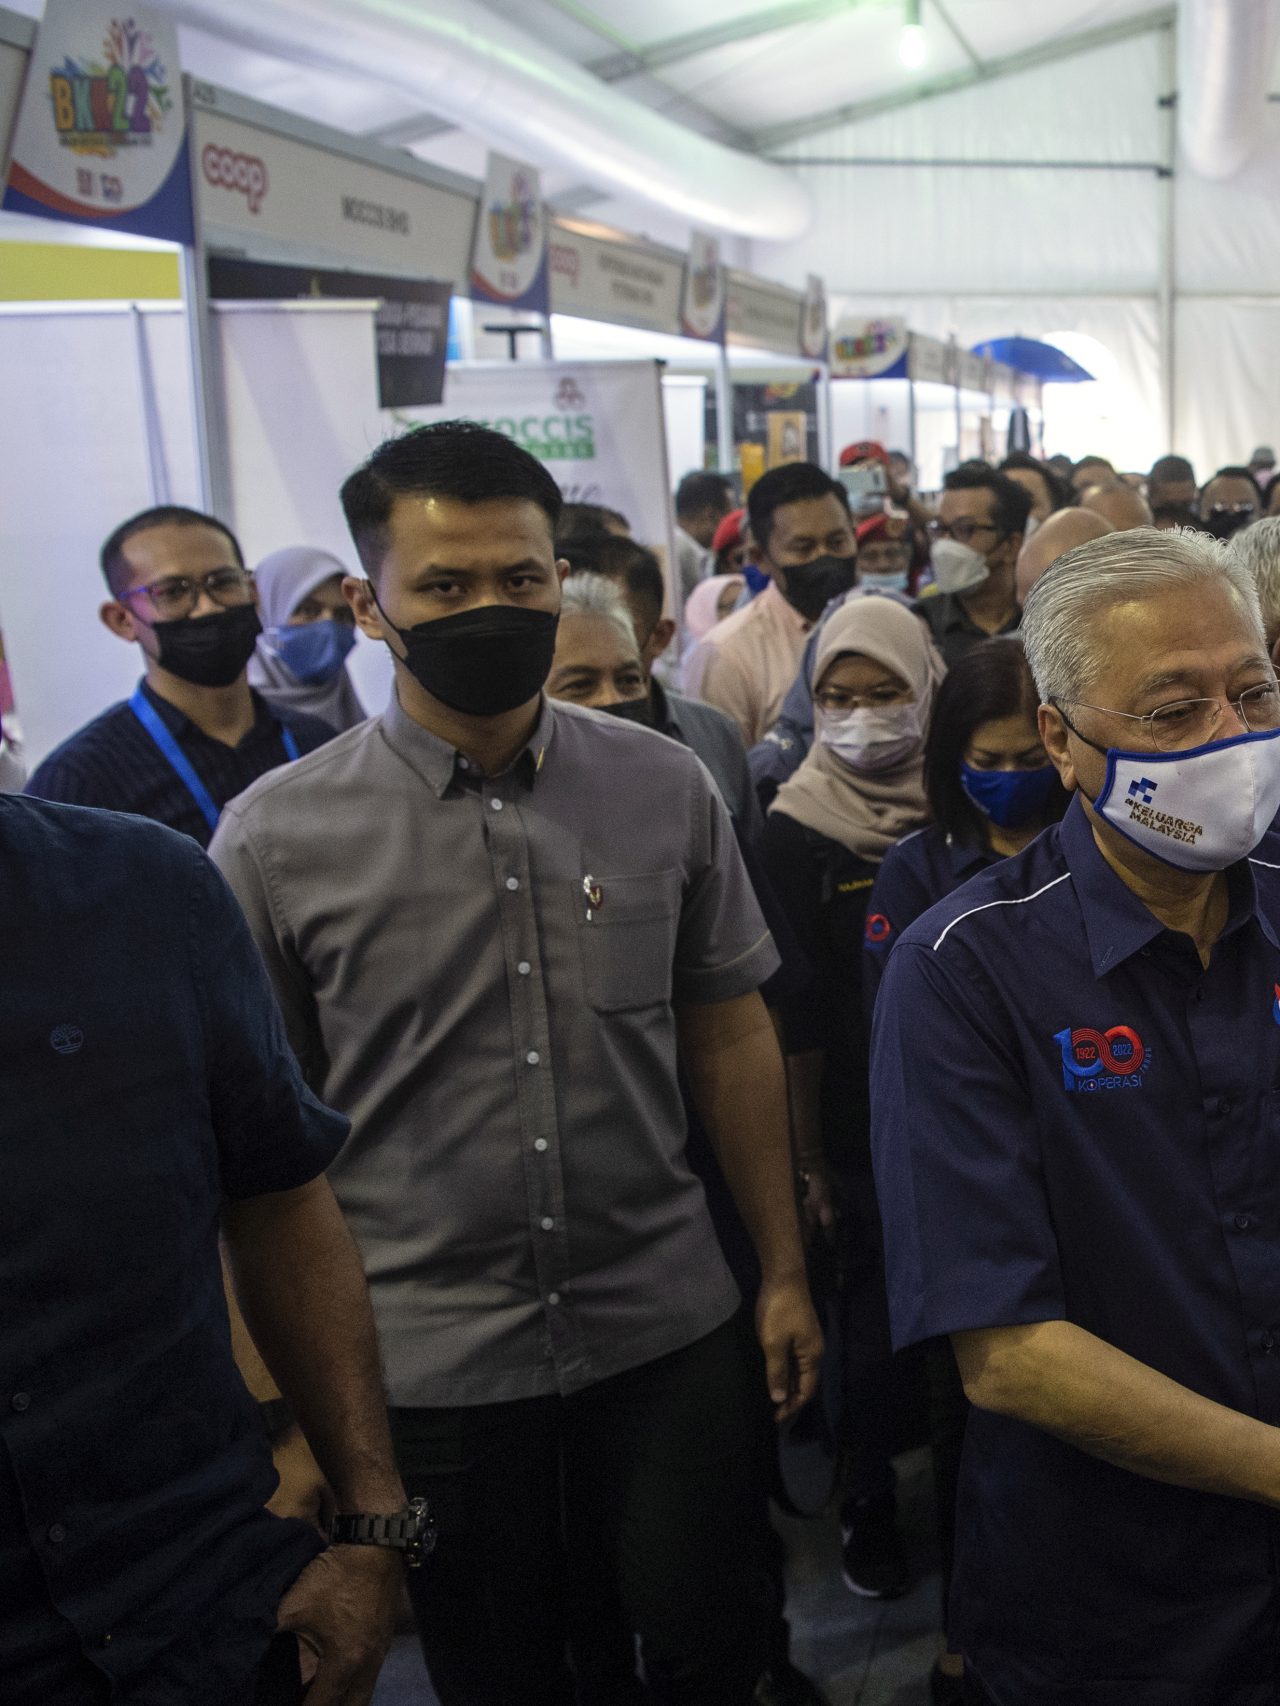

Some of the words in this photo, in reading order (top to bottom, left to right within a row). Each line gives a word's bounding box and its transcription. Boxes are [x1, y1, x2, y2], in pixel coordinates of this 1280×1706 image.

[203, 142, 269, 216] coop
[1129, 810, 1197, 845] MALAYSIA
[1076, 1046, 1096, 1059] 1922
[1112, 1043, 1133, 1057] 2022
[1078, 1074, 1143, 1092] KOPERASI
